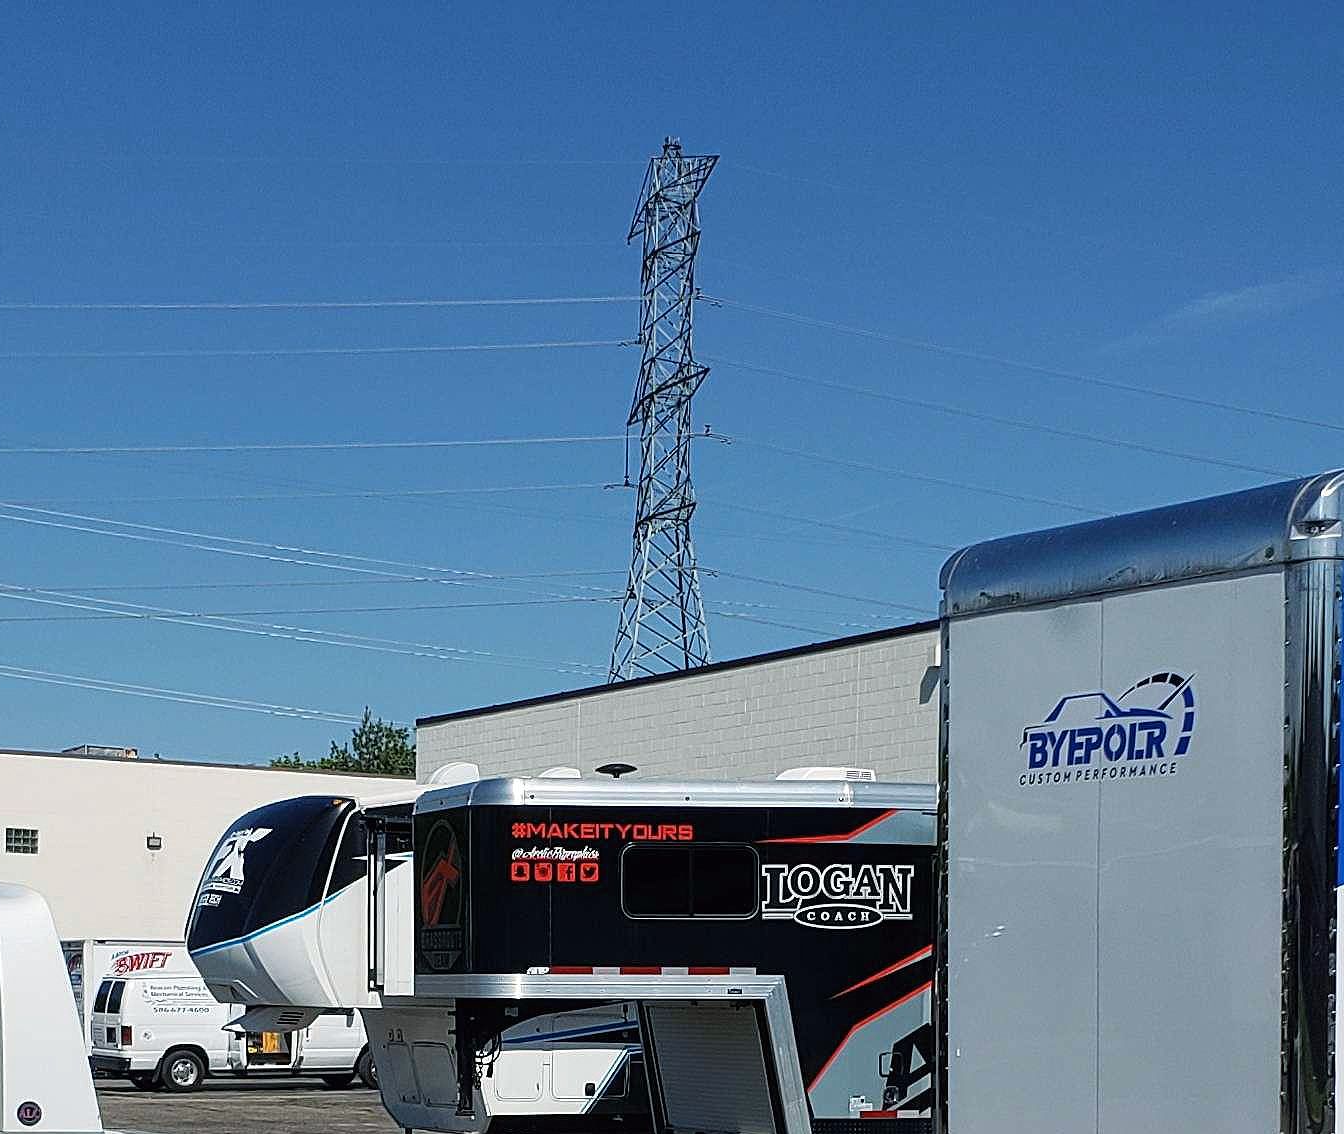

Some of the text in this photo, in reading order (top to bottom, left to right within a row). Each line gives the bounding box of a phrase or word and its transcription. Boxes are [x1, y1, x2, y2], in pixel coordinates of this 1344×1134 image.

[1029, 721, 1168, 769] BYEPOLR
[1019, 762, 1177, 786] CUSTOM PERFORMANCE
[511, 823, 694, 841] #MAKEITYOURS
[761, 863, 915, 913] LOGAN
[806, 911, 871, 922] COACH
[113, 951, 173, 977] SWIFT
